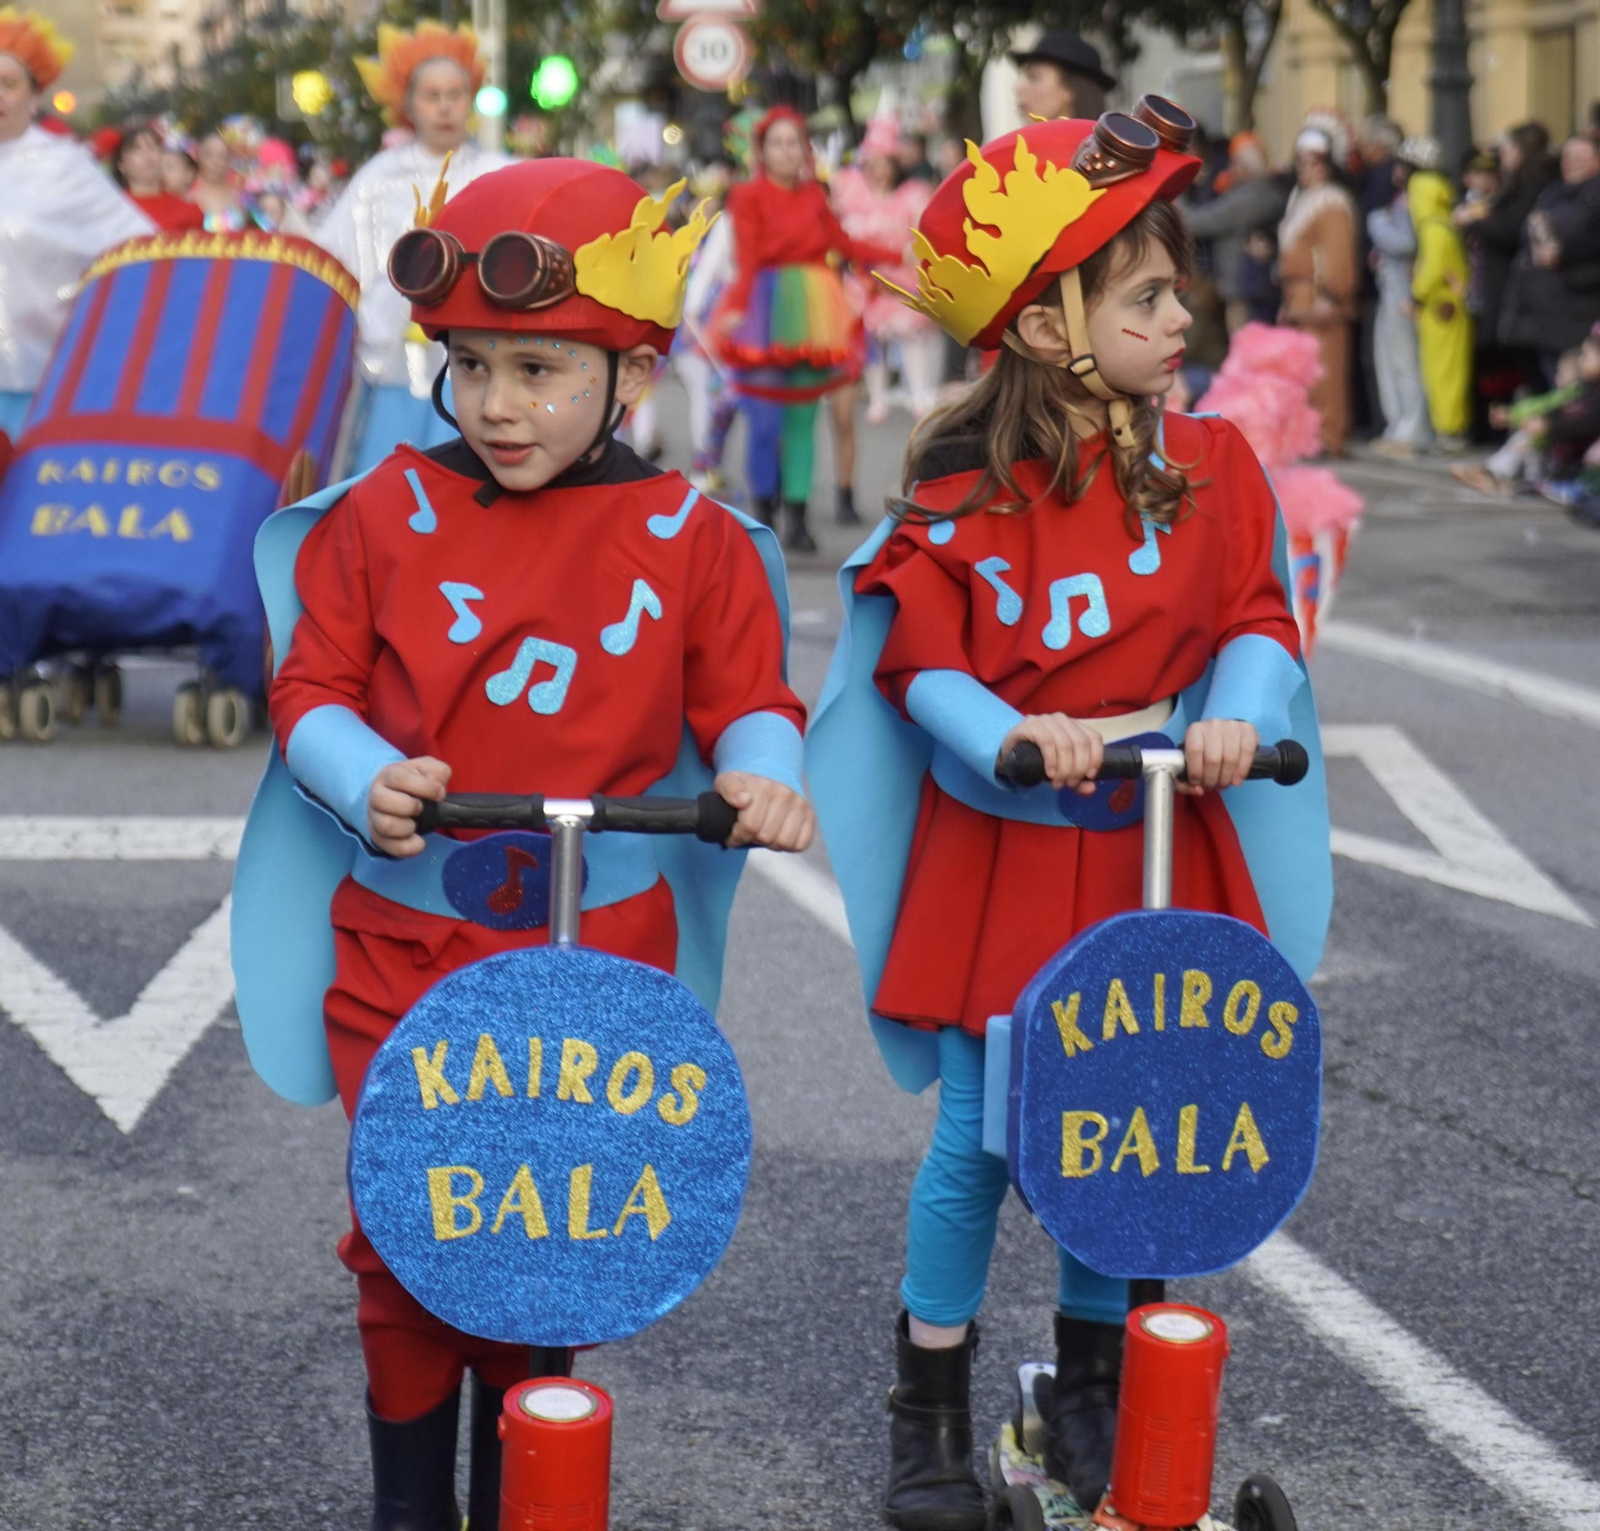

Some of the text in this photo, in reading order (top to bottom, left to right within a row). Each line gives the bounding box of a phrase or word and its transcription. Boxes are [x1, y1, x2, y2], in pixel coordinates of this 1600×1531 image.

[37, 459, 220, 491] KAIROS
[31, 504, 192, 542] BALA
[1051, 969, 1298, 1059] KAIROS
[411, 1033, 707, 1125] KAIROS
[1061, 1102, 1270, 1178] BALA
[427, 1163, 672, 1241] BALA
